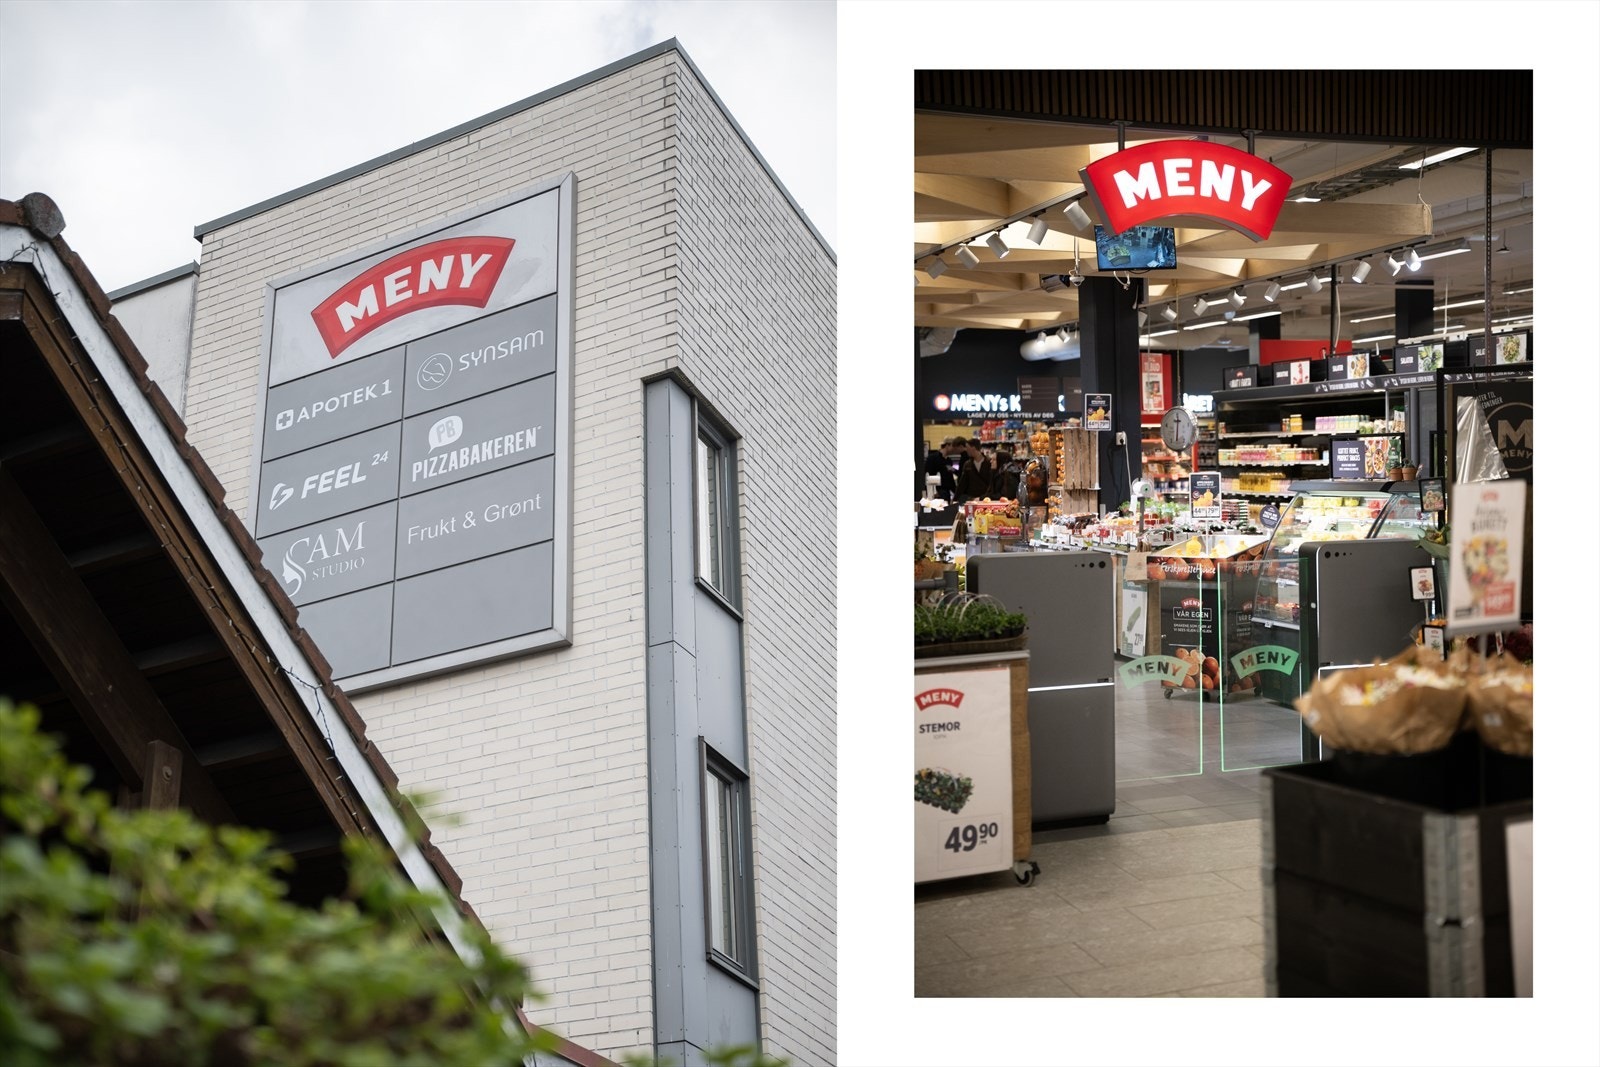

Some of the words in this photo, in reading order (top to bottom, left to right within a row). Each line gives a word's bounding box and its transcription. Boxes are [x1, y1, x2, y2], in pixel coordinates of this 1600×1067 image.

[1113, 158, 1272, 211] MENY
[335, 253, 493, 333] MENY
[458, 329, 544, 371] SYNSAM
[297, 383, 378, 423] APOTEK
[381, 379, 392, 396] 1
[435, 419, 457, 445] PB
[1497, 418, 1533, 450] M
[412, 427, 538, 482] PIZZABAKEREN
[1501, 448, 1533, 459] MENY
[301, 462, 367, 499] FEEL
[371, 451, 388, 467] 24
[407, 516, 457, 545] Frukt
[462, 510, 476, 529] &
[484, 493, 542, 522] Grønt
[312, 556, 365, 581] STUDIO
[1176, 610, 1190, 618] VÅR
[1183, 599, 1202, 607] MENY
[1127, 660, 1183, 677] MENY
[1240, 651, 1291, 671] MENY
[920, 691, 960, 706] MENY
[919, 721, 961, 734] STEMOR
[944, 824, 978, 854] 49
[979, 822, 999, 839] 90
